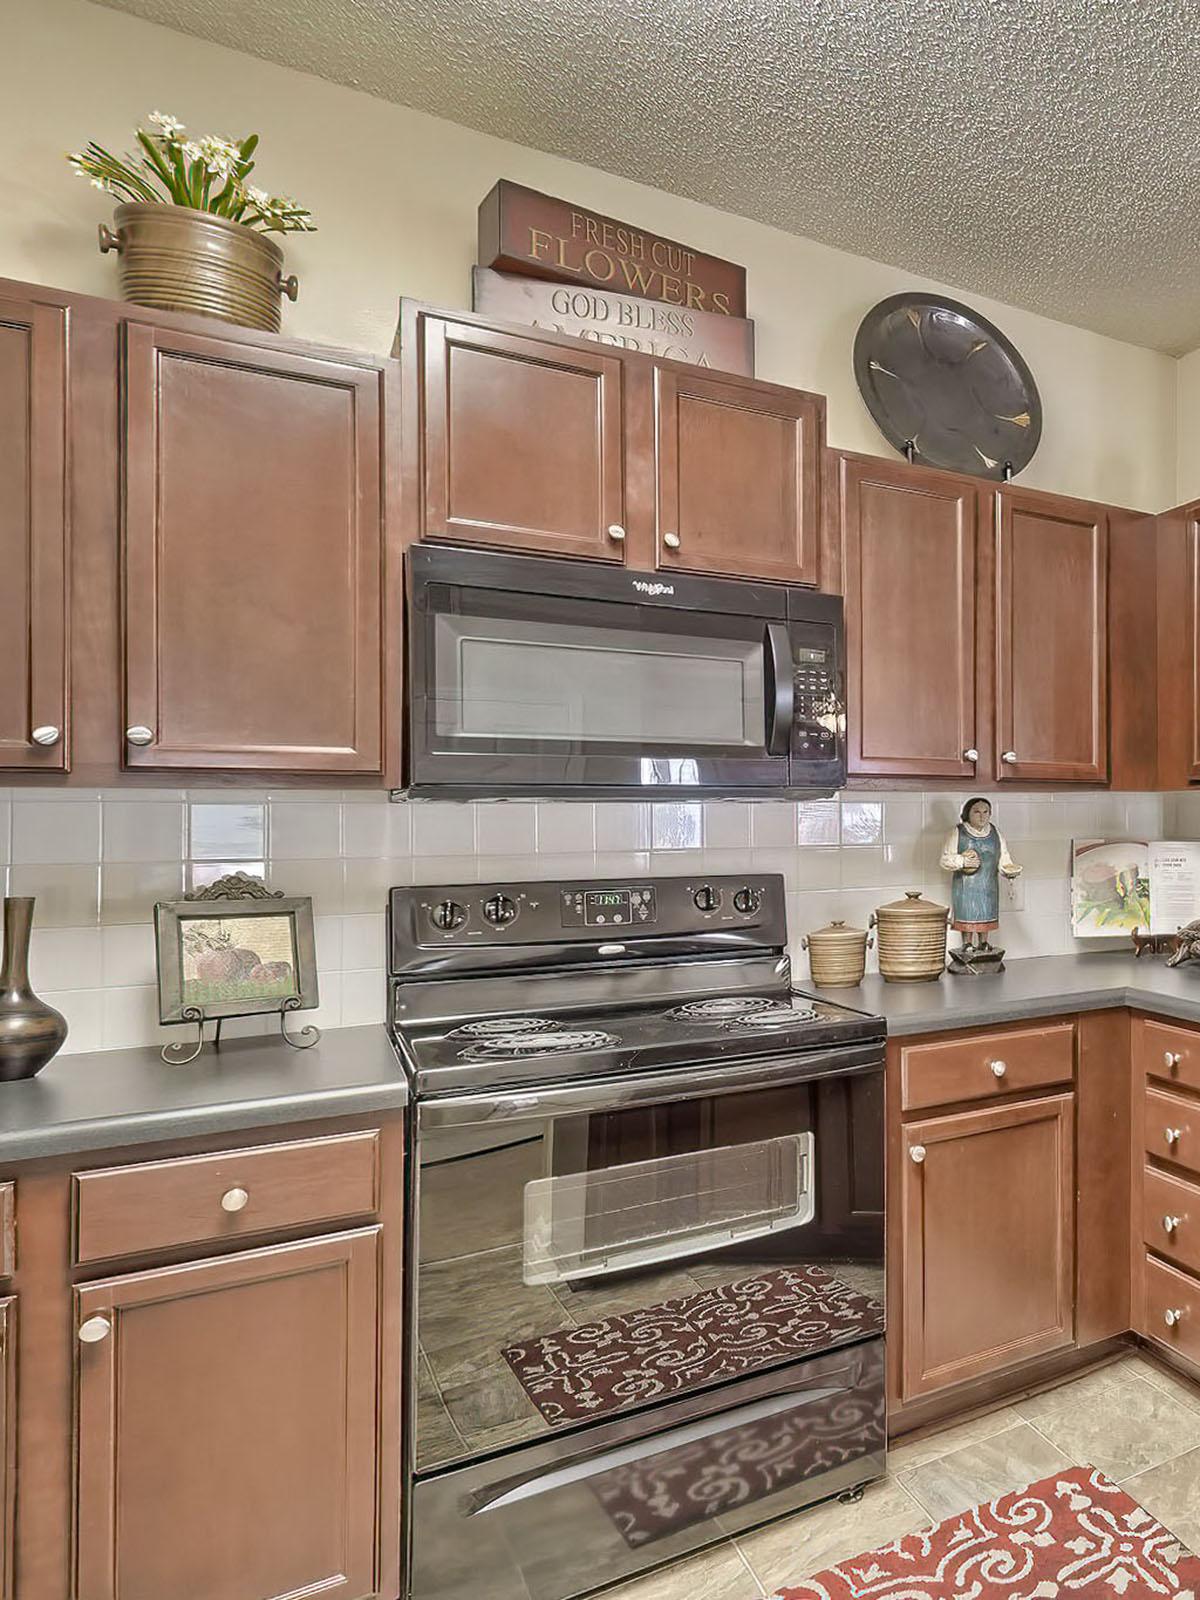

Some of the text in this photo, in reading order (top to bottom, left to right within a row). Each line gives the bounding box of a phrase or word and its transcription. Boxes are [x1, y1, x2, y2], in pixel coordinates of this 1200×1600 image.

[526, 227, 731, 316] FLOWERS
[571, 212, 696, 277] FRESH CUT
[551, 288, 695, 337] GOD BLESS
